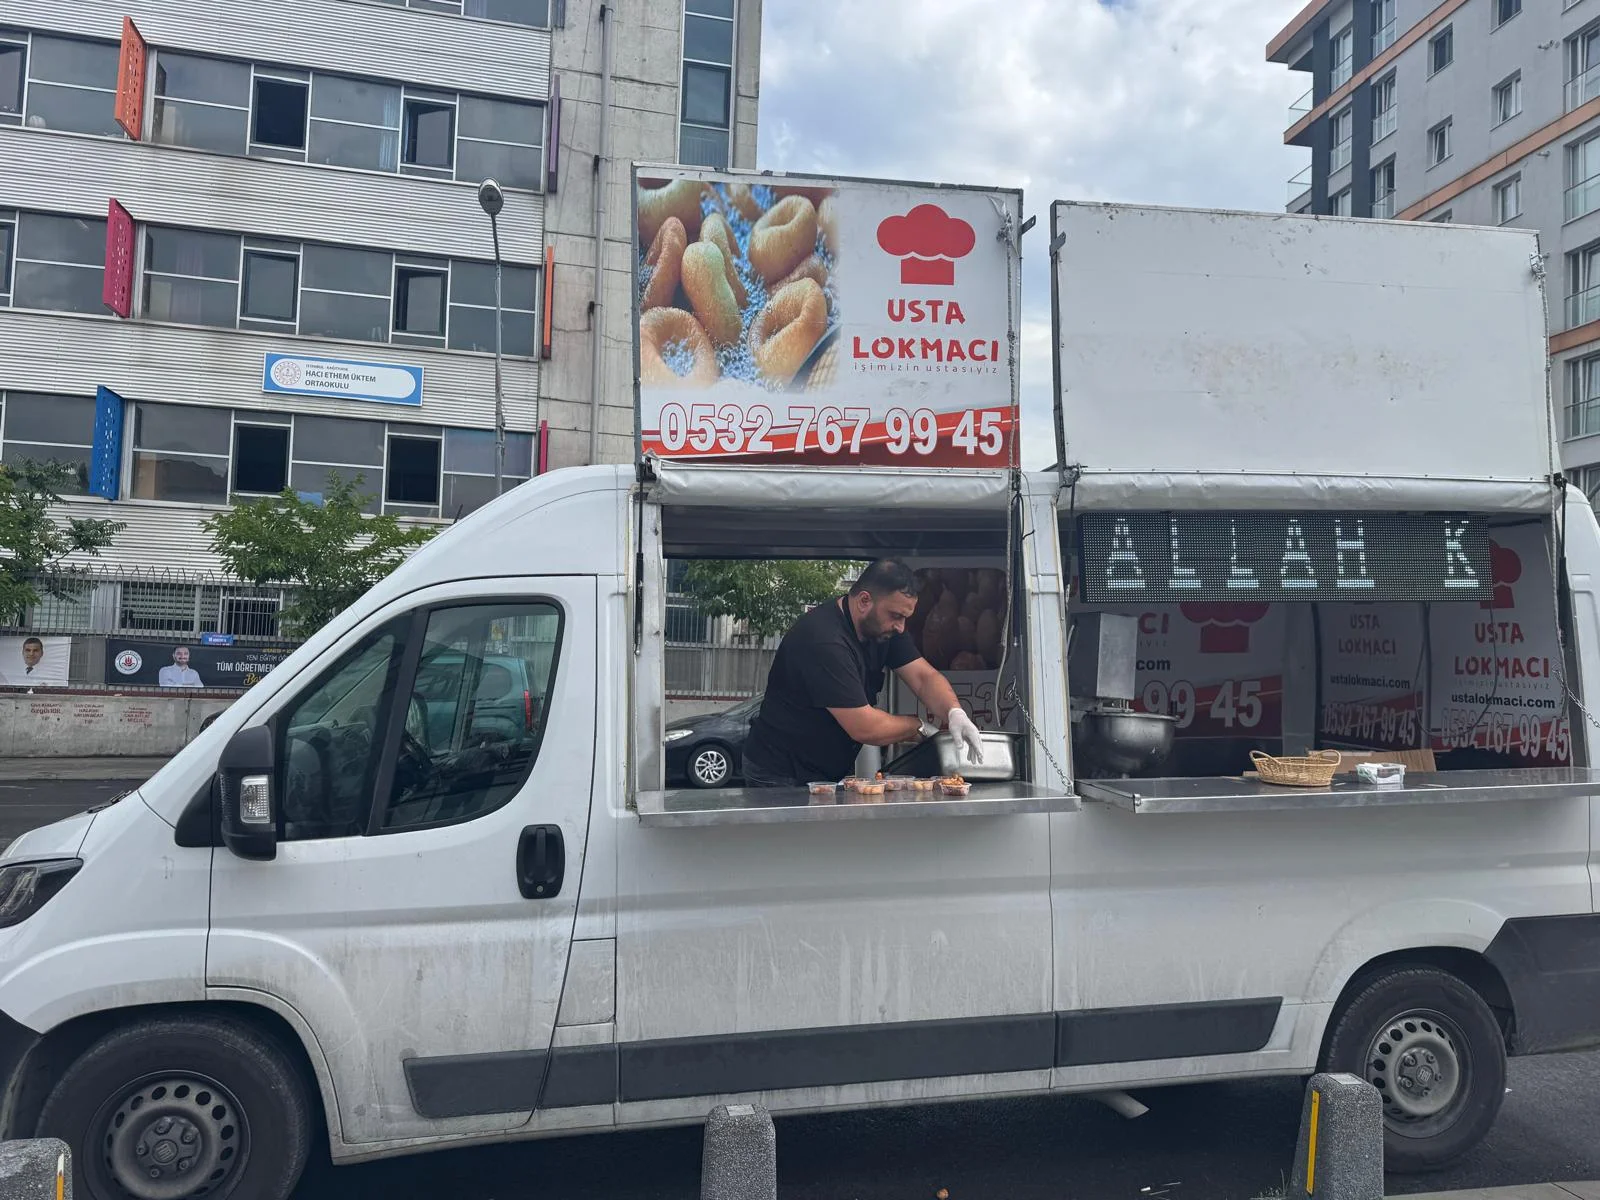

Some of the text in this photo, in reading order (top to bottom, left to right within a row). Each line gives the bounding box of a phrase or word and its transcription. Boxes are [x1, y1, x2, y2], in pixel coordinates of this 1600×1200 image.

[887, 299, 966, 325] USTA
[852, 336, 998, 362] LOKMACI
[305, 370, 377, 383] HACI ETHEM ÜKTEM
[854, 362, 998, 375] işimizin ustasıyız
[304, 379, 350, 389] ORTAOKULU
[658, 401, 1004, 456] 0532 767 99 45
[1106, 518, 1479, 588] ALLAH K
[1349, 613, 1382, 630] USTA
[1474, 621, 1525, 645] USTA
[1337, 638, 1397, 656] LOKMACI
[216, 660, 233, 672] TÜM
[1453, 655, 1550, 679] LOKMACI
[1331, 673, 1411, 689] ustalokmaci.com
[1142, 680, 1263, 729] 99 45
[1451, 693, 1556, 709] ustalokmaci.com
[1380, 706, 1396, 743] 99
[1398, 708, 1416, 747] 45
[1480, 711, 1514, 755] 767
[1520, 713, 1541, 758] 99
[1545, 716, 1570, 761] 45
